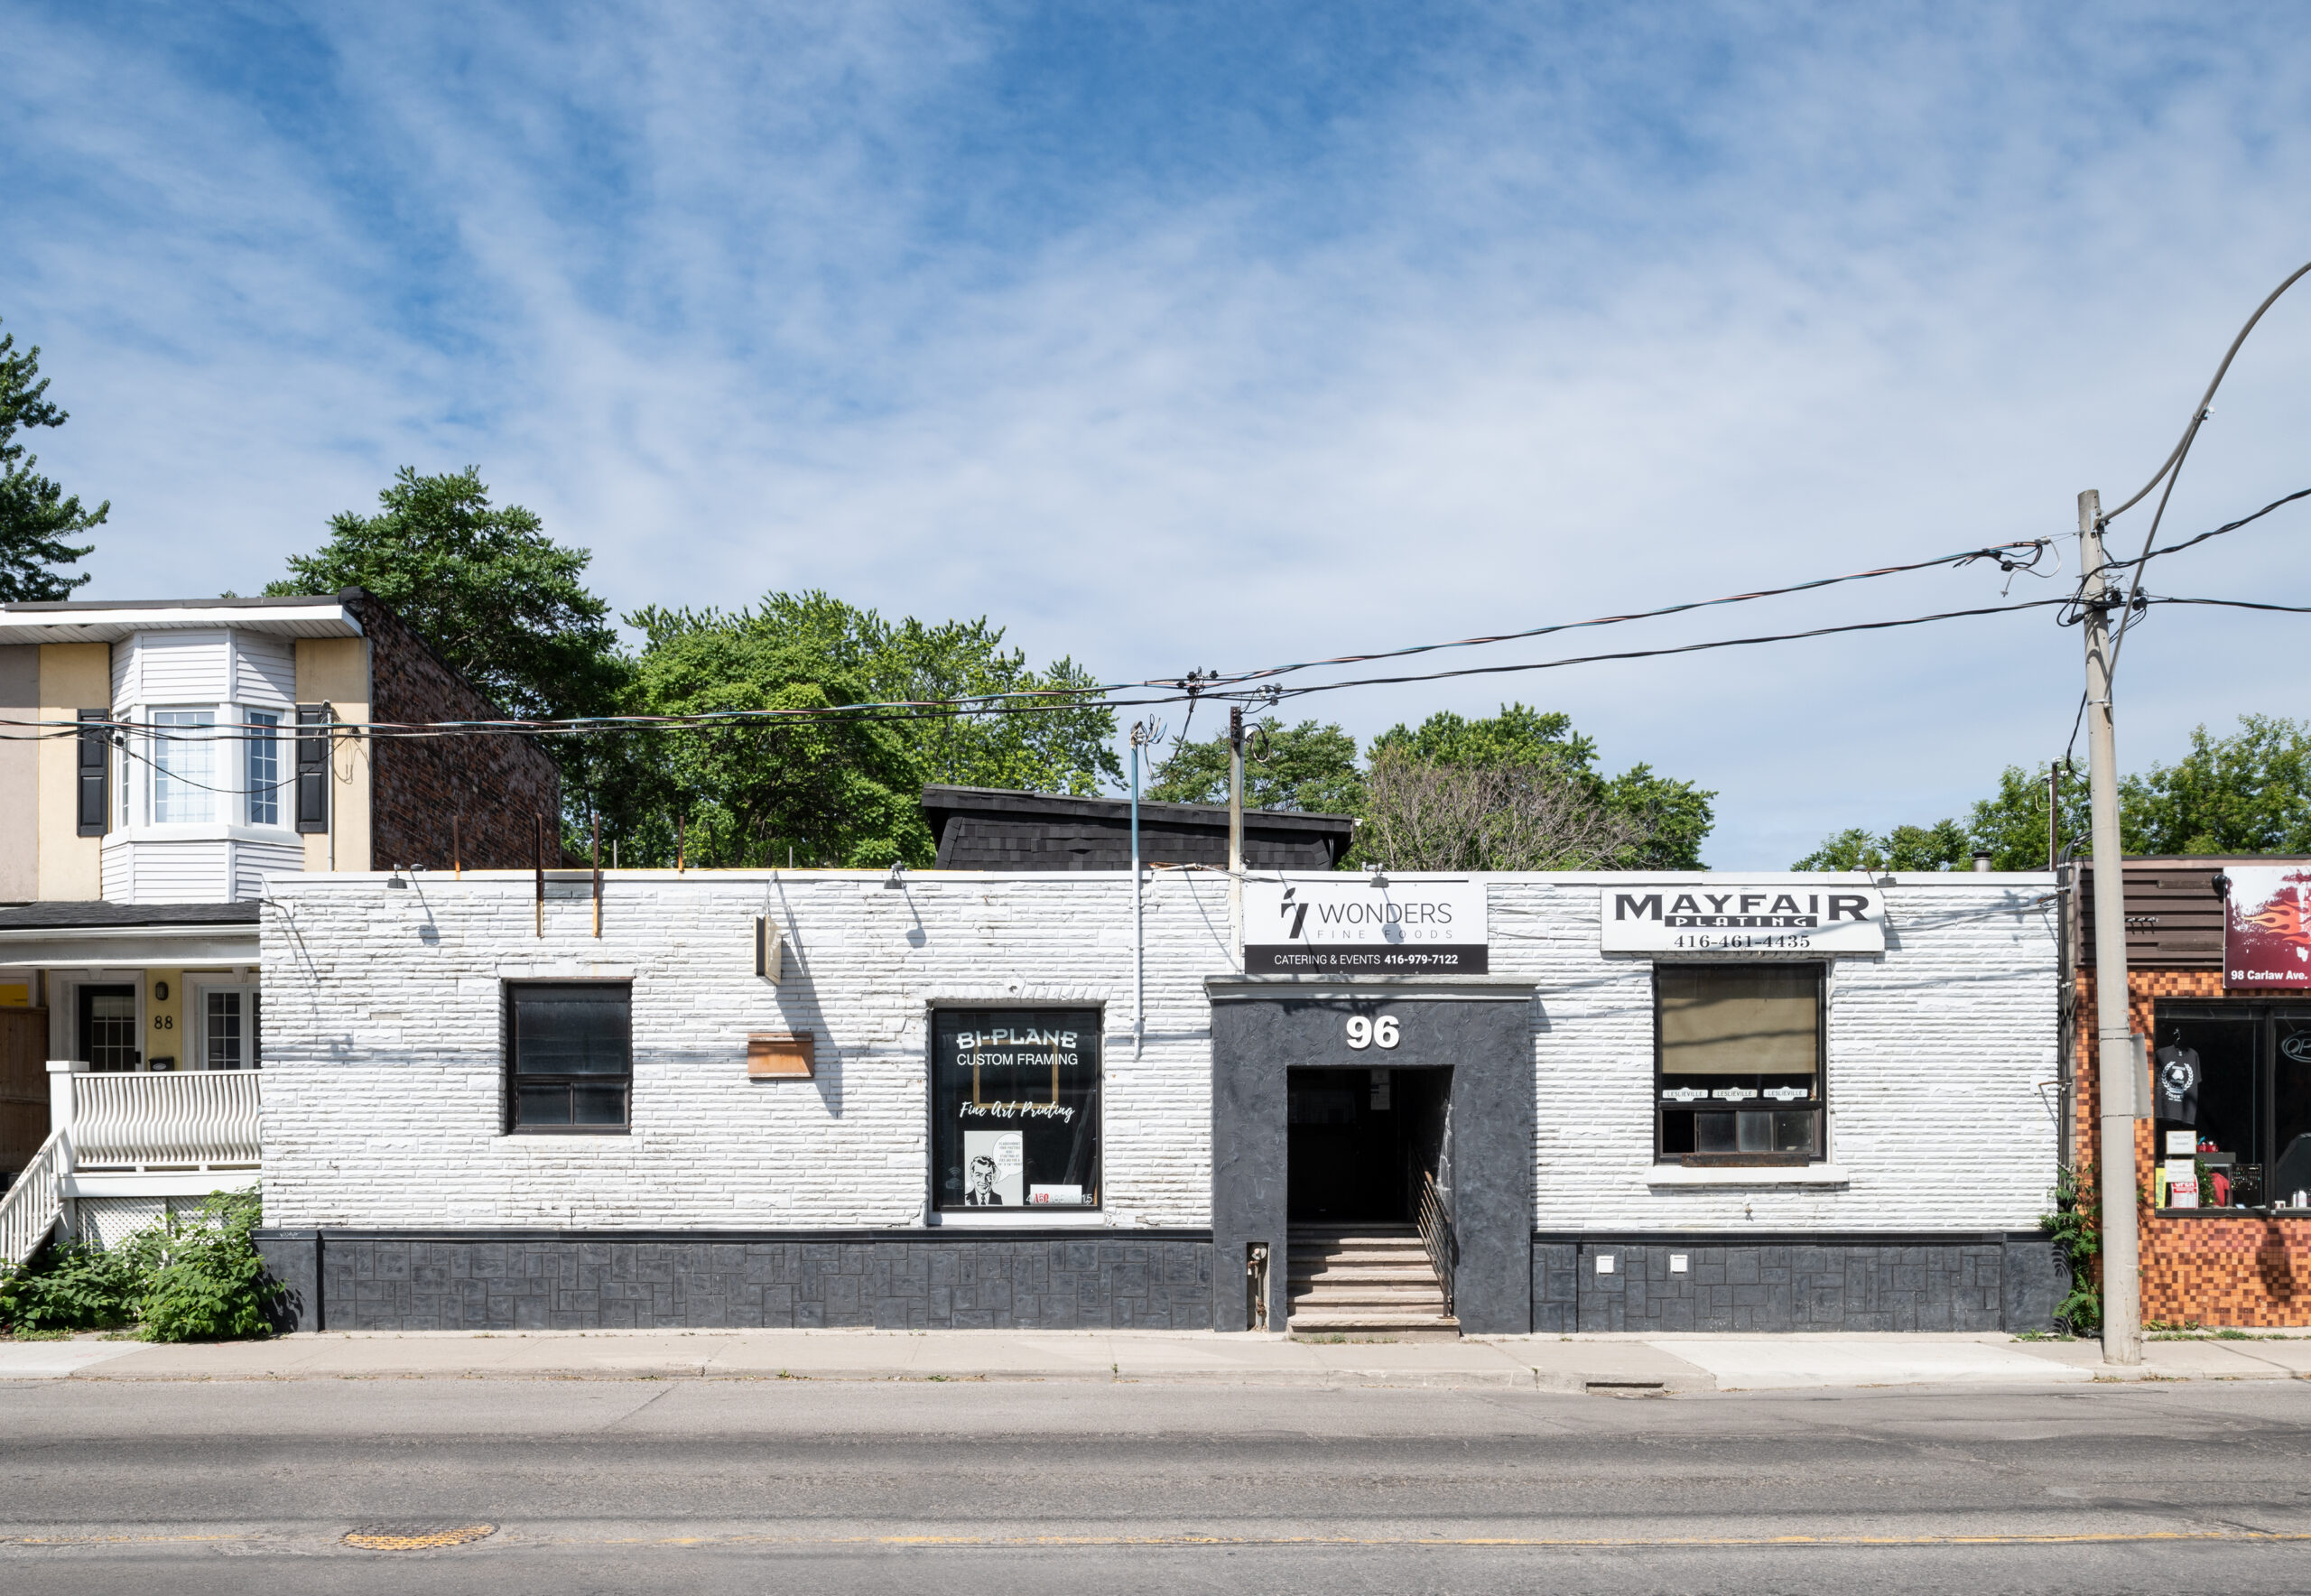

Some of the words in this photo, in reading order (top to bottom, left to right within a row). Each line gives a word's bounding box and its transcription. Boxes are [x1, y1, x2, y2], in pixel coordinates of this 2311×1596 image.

[1614, 894, 1870, 921] MAYFAIR
[1280, 903, 1309, 939] 7
[1318, 903, 1452, 923] WONDERS
[1675, 916, 1807, 927] PLATING
[1317, 930, 1366, 939] FINE
[1384, 930, 1452, 940] FOODS
[1674, 934, 1811, 949] 416-461-4435
[1274, 954, 1328, 965] CATERING
[1330, 954, 1338, 965] &
[1340, 954, 1381, 965] EVENTS
[1384, 954, 1459, 965] 416-979-7122
[2231, 970, 2244, 980] 98
[2247, 970, 2284, 980] Carlaw
[2286, 970, 2308, 980] Ave.
[153, 1016, 173, 1030] 88
[957, 1028, 1078, 1050] BI-PLANE
[1346, 1016, 1400, 1049] 96
[957, 1053, 1014, 1066] CUSTOM
[1017, 1053, 1078, 1066] FRAMING
[960, 1101, 987, 1118] Fine
[991, 1100, 1015, 1118] Art
[1020, 1101, 1074, 1123] Printing
